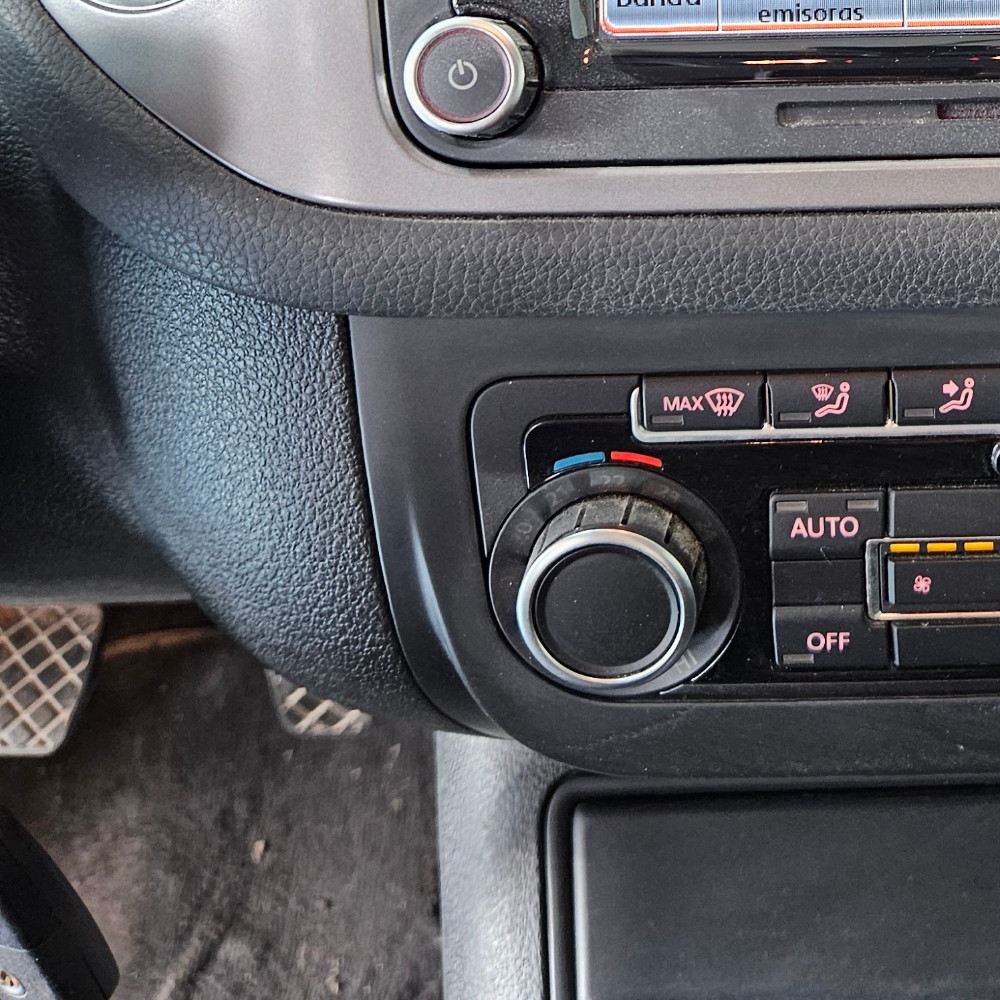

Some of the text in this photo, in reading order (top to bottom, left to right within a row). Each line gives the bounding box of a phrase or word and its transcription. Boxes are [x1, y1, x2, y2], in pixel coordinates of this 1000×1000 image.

[758, 2, 864, 24] emisoras
[663, 395, 704, 413] MAX
[790, 515, 860, 539] AUTO
[806, 631, 851, 653] OFF
